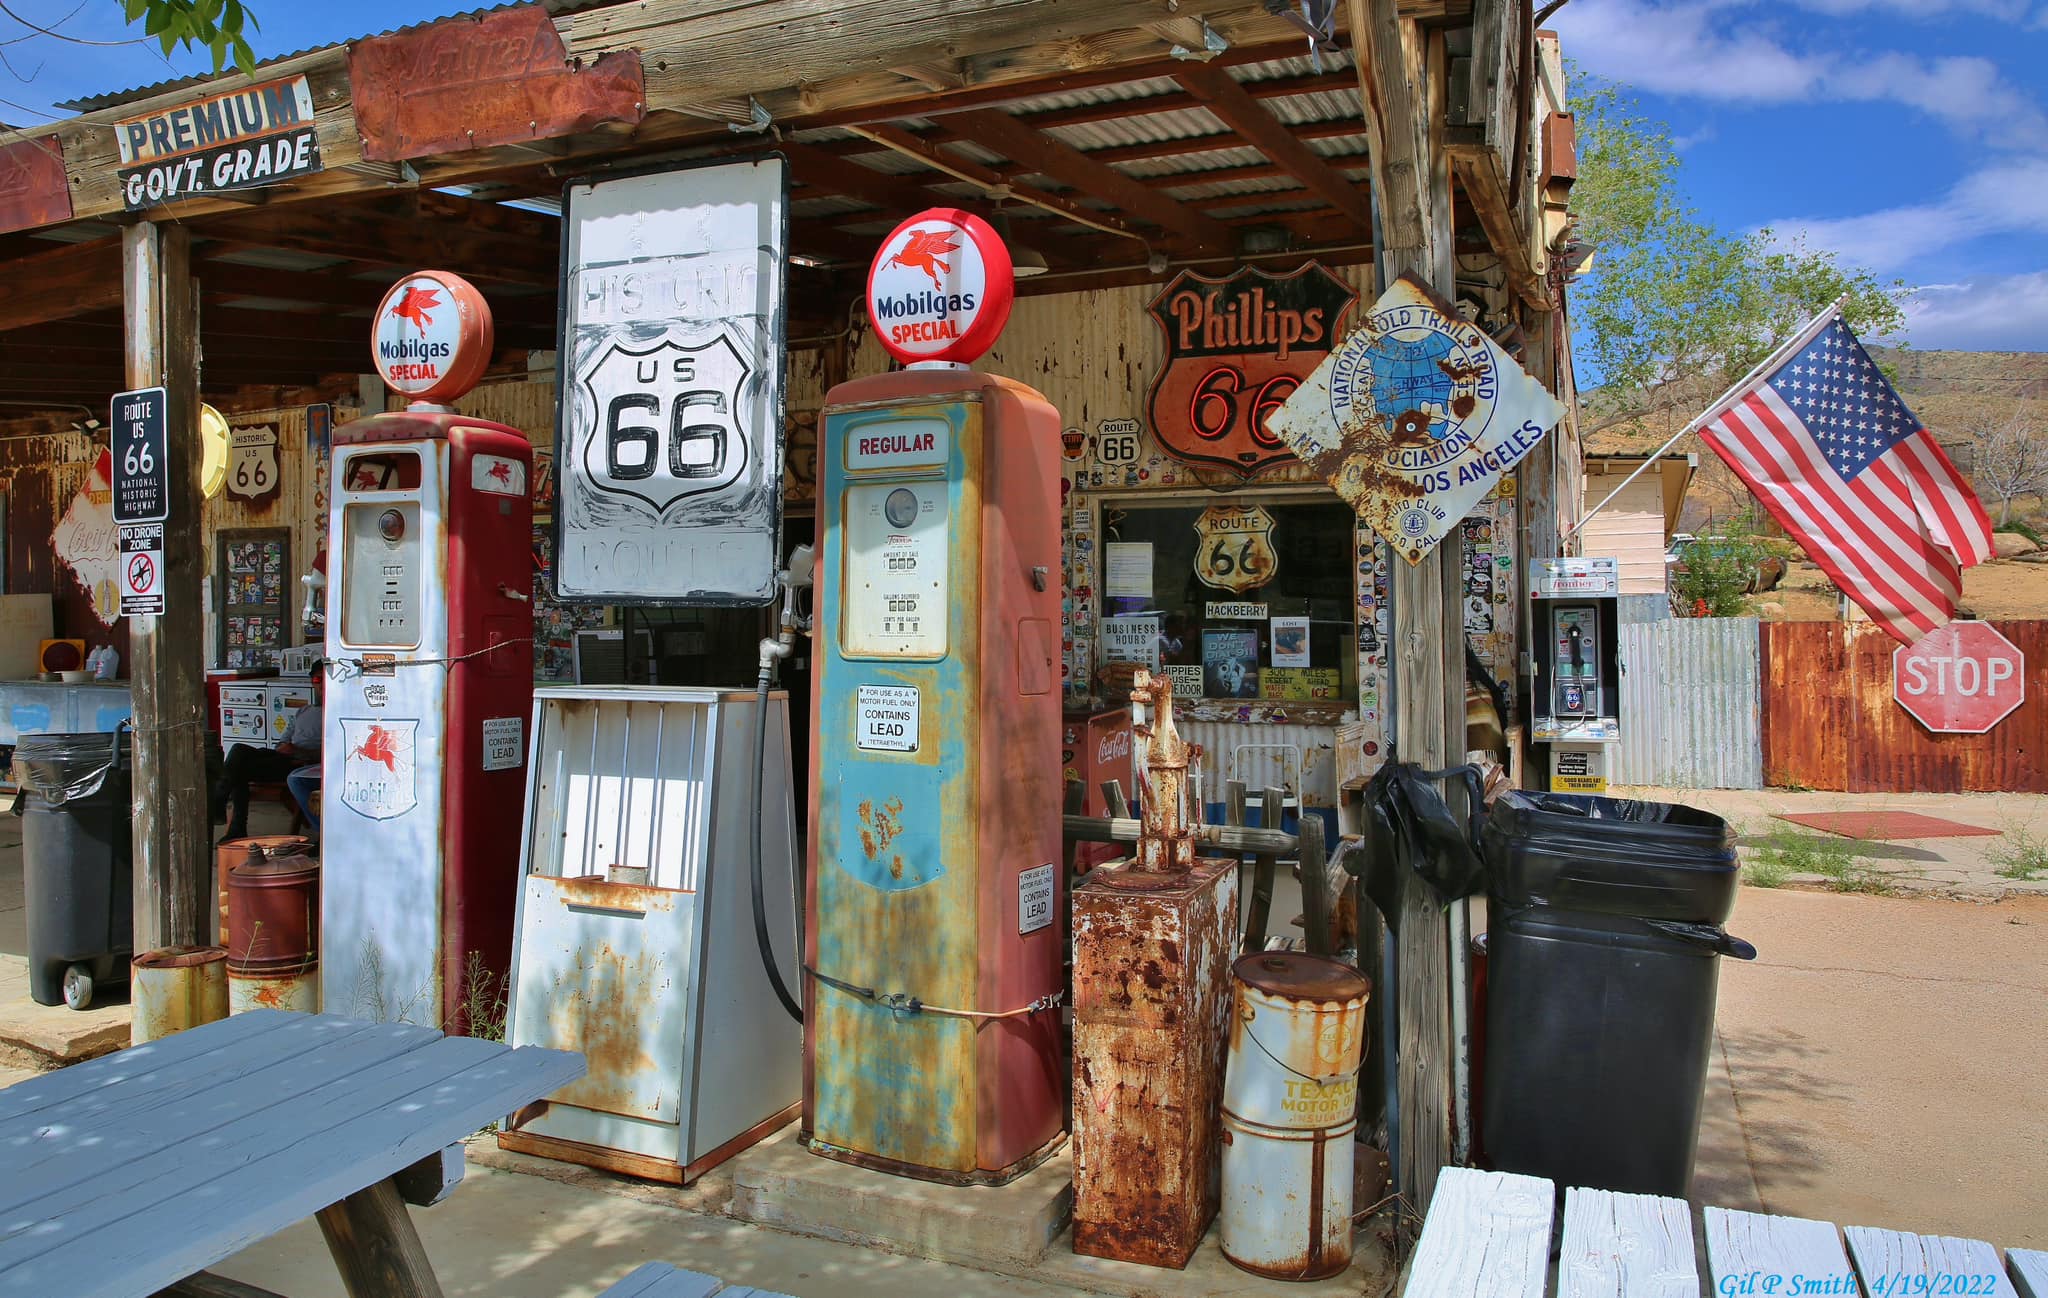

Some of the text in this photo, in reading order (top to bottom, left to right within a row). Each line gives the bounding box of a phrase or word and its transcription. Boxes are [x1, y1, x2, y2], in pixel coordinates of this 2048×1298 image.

[127, 82, 300, 161] PREMIUM
[127, 133, 312, 205] GOV'T. GRADE
[878, 290, 975, 320] Mobilgas
[892, 319, 961, 345] SPECIAL
[1169, 287, 1325, 361] Phillips
[380, 338, 450, 363] Mobilgas
[1378, 309, 1411, 332] OLD
[1419, 309, 1475, 349] TRAILS
[1470, 334, 1495, 400] ROAD
[389, 364, 439, 381] SPECIAL
[123, 401, 153, 421] ROUTE
[1189, 367, 1302, 450] 66
[133, 421, 145, 439] US
[605, 391, 728, 481] 66
[1104, 423, 1134, 433] ROUTE
[235, 433, 267, 444] HISTORIC
[859, 432, 935, 456] REGULAR
[1103, 436, 1135, 461] 66
[1387, 429, 1473, 468] OCIATION
[1458, 419, 1544, 487] ANGELES
[124, 441, 155, 476] 66
[236, 459, 267, 488] 66
[121, 478, 158, 489] NATIONAL
[122, 488, 157, 500] HISTORIC
[124, 500, 156, 512] HIGHWAY
[1416, 498, 1446, 522] CLUB
[1209, 516, 1260, 530] ROUTE
[121, 526, 161, 541] NO DRONE
[1415, 533, 1442, 550] CAL.
[129, 539, 152, 551] ZONE
[1209, 537, 1260, 576] 66
[1207, 604, 1266, 617] HACKBERRY
[1106, 623, 1156, 634] BUSINESS
[1217, 633, 1239, 641] WE
[1115, 634, 1146, 645] HOURS
[1209, 640, 1246, 650] DON'T
[1160, 666, 1201, 676] HIPPIES
[1300, 669, 1327, 679] MILES
[1903, 656, 2014, 697] STOP
[880, 689, 892, 697] USE
[1180, 684, 1202, 695] DOOR
[1311, 687, 1329, 698] ICE
[864, 709, 911, 721] CONTAINS
[870, 722, 904, 737] LEAD
[488, 736, 519, 747] CONTAINS
[492, 747, 515, 759] LEAD
[1023, 887, 1050, 904] CONTAINS
[1027, 901, 1047, 919] LEAD
[1281, 1098, 1338, 1113] MOTOR
